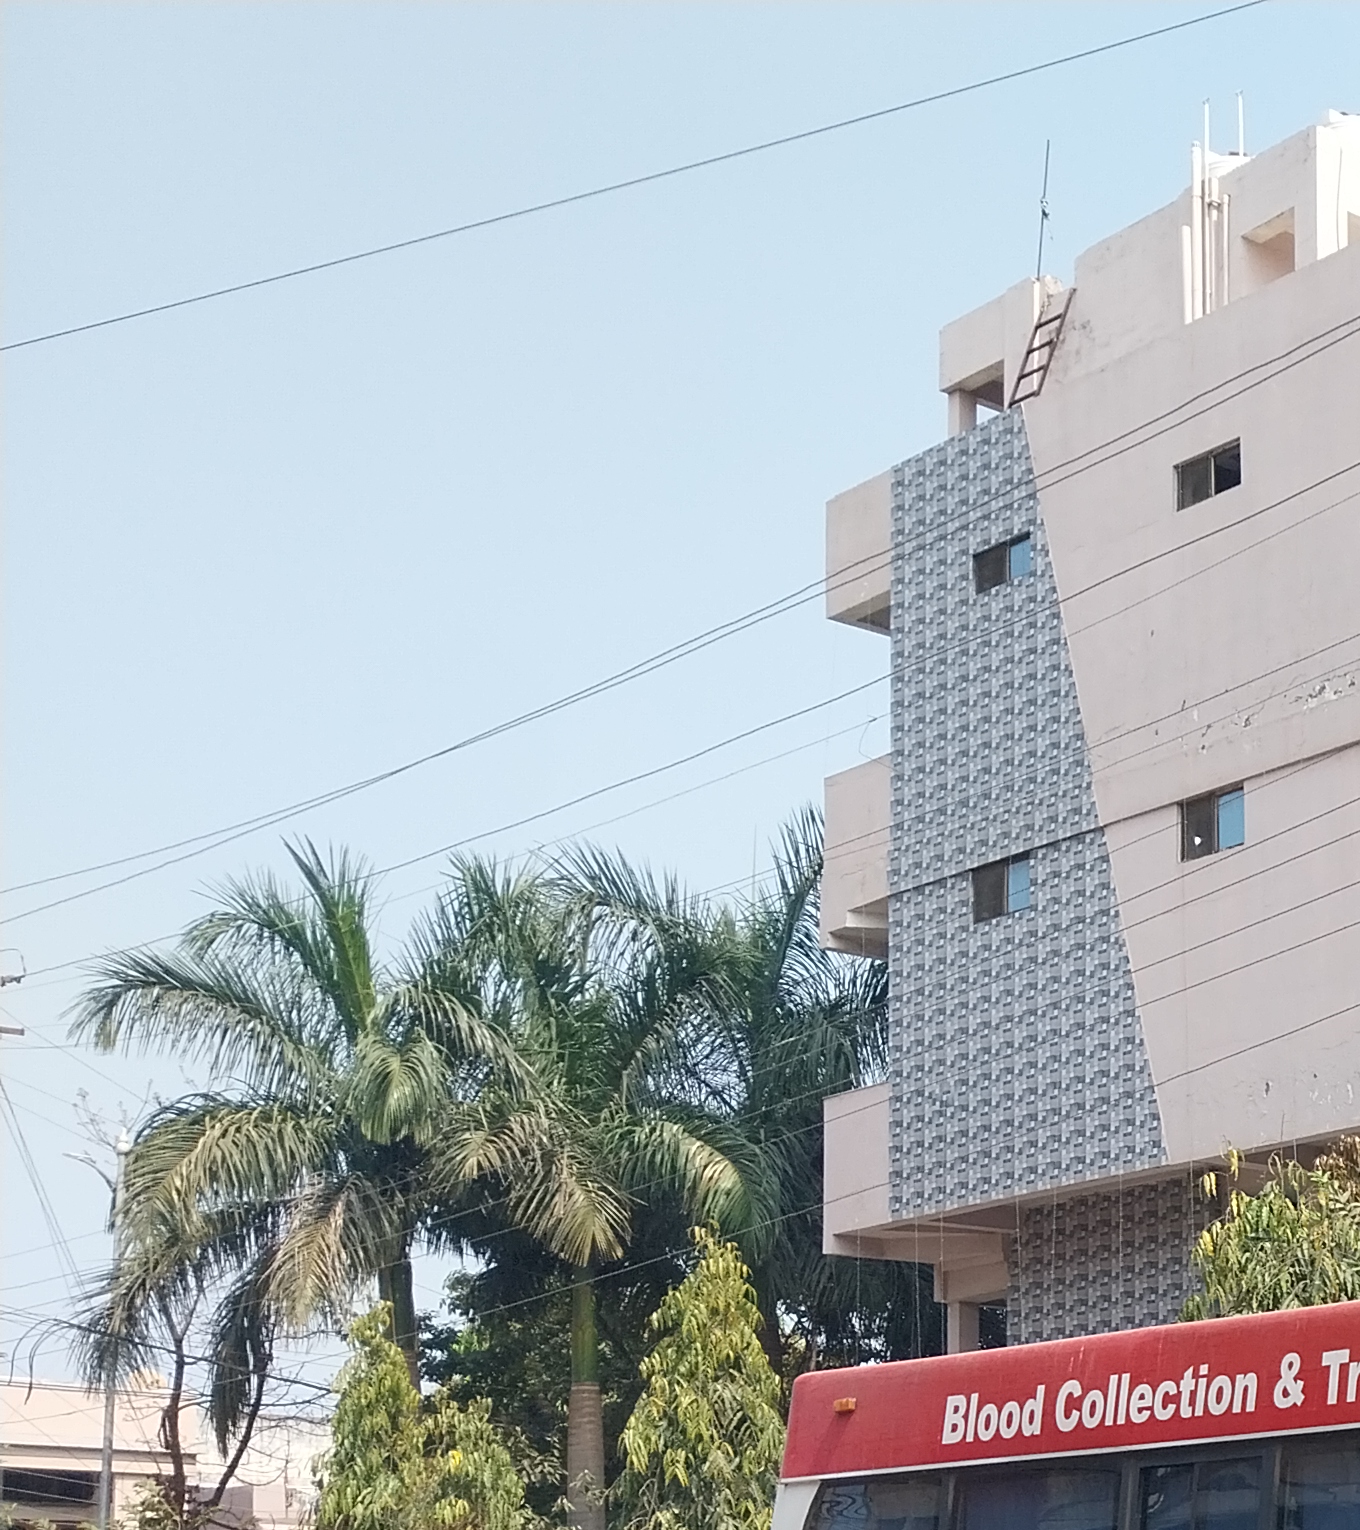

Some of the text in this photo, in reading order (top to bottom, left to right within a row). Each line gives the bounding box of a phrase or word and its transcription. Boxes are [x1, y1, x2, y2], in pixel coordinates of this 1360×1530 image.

[941, 1384, 1045, 1445] Blood
[1055, 1364, 1257, 1432] Collection
[1274, 1352, 1305, 1407] &
